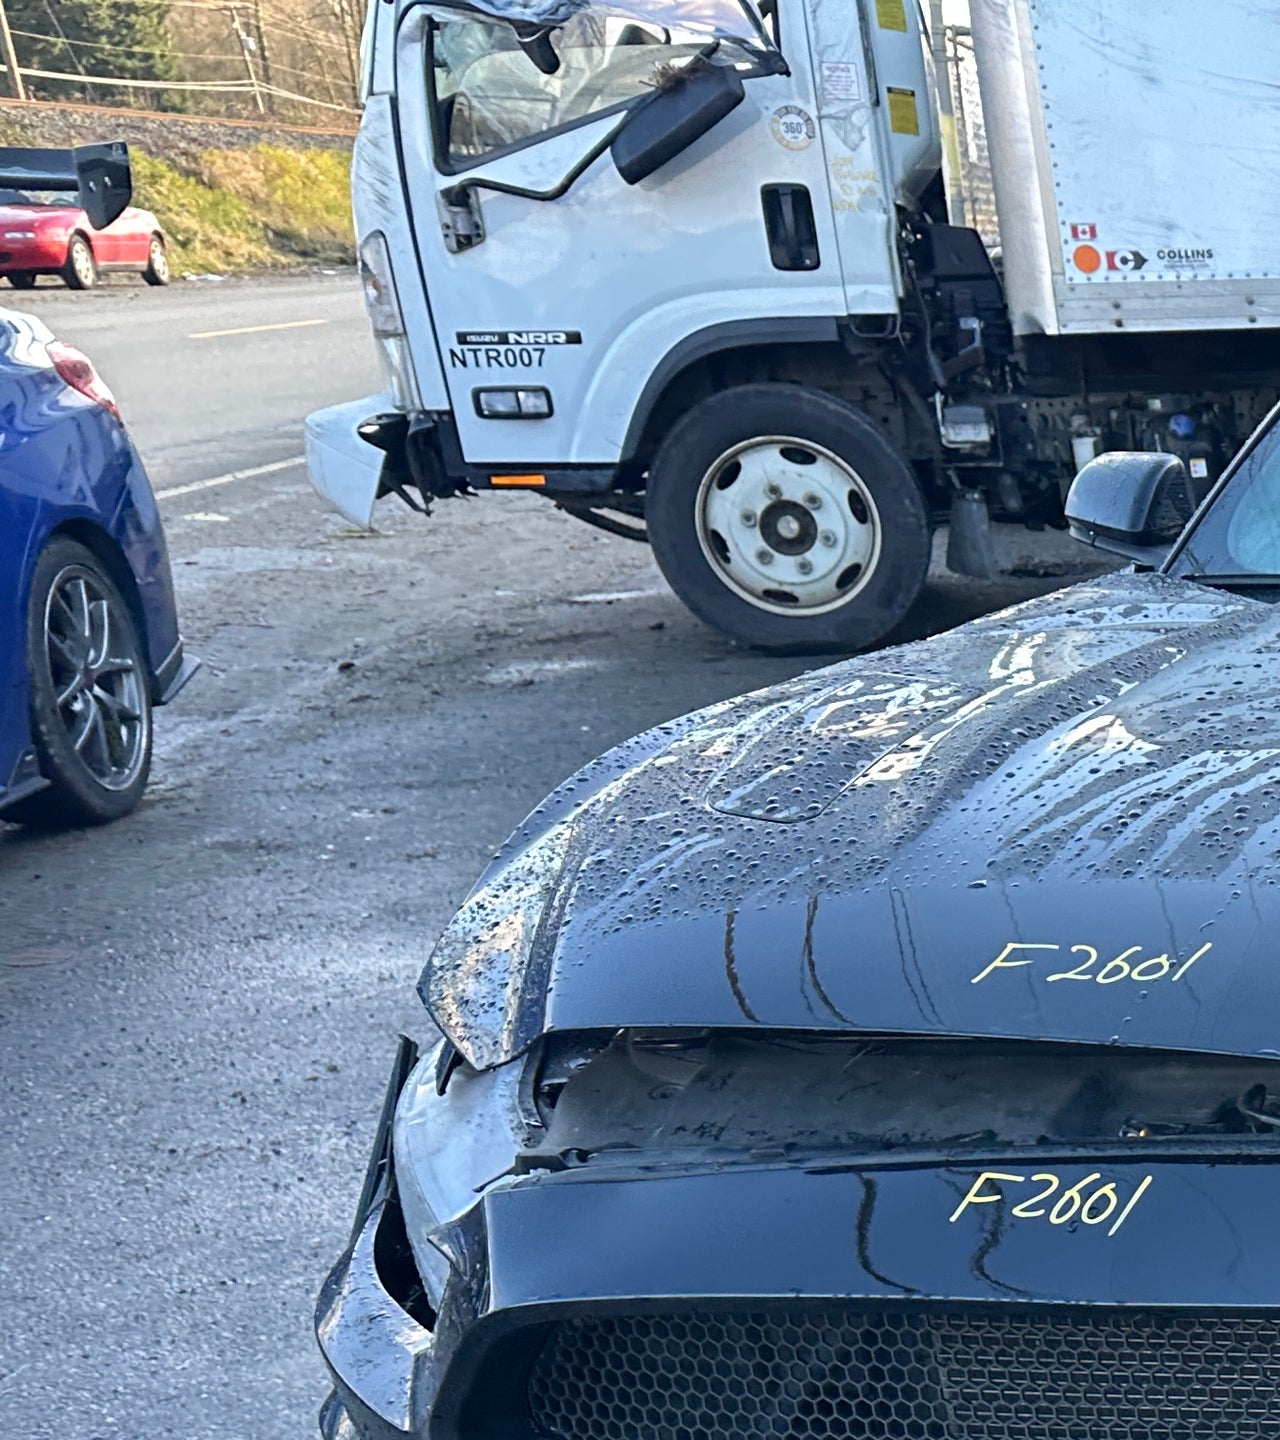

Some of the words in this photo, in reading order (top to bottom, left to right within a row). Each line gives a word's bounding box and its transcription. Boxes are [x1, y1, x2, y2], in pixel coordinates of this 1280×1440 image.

[1156, 248, 1213, 260] COLLINS
[466, 334, 499, 343] ISUZU
[507, 332, 567, 344] NRR
[448, 347, 546, 368] NTR007
[971, 942, 1212, 984] F2601
[949, 1172, 1153, 1237] F2601
